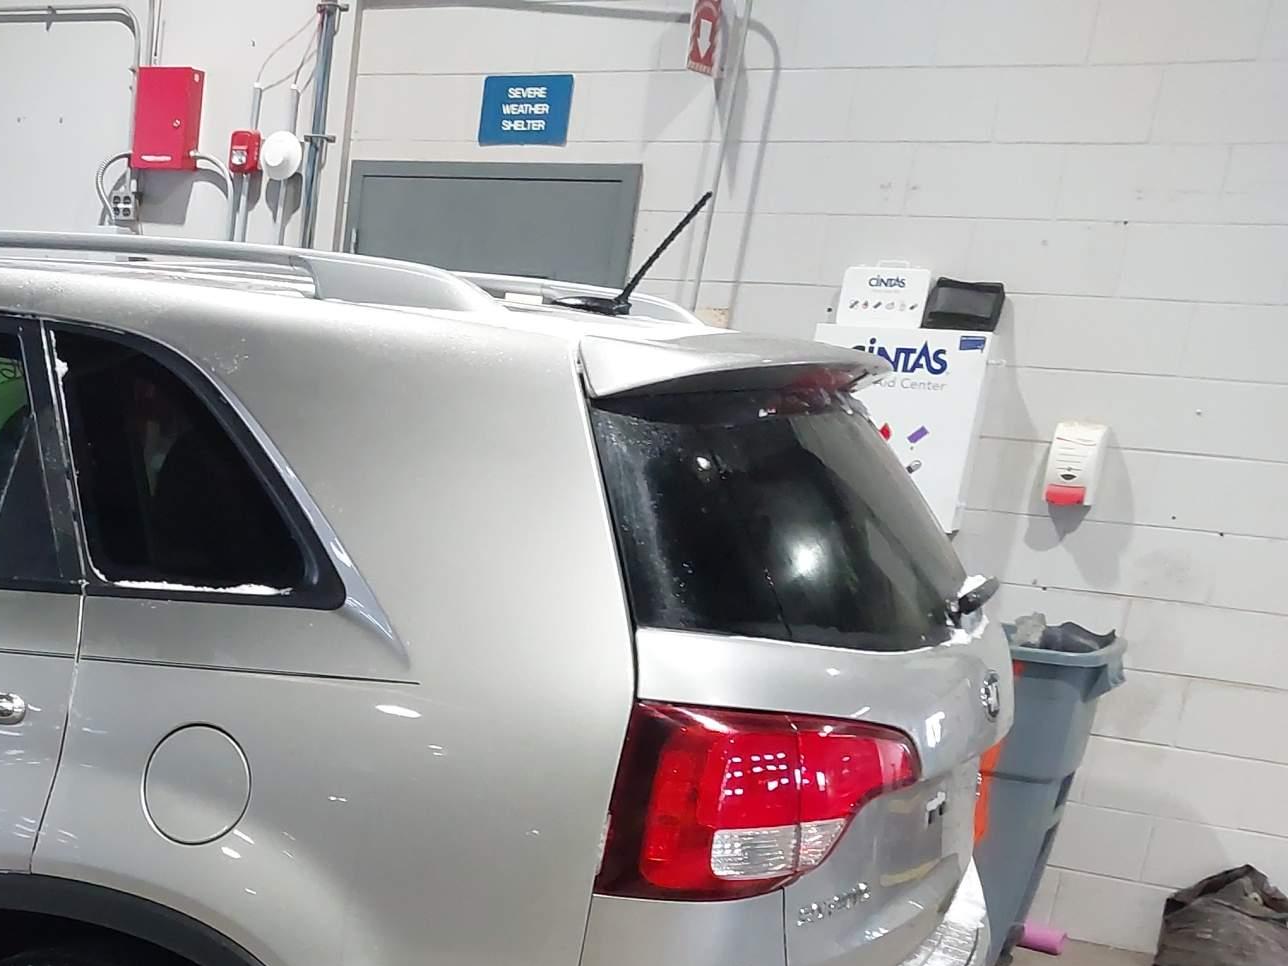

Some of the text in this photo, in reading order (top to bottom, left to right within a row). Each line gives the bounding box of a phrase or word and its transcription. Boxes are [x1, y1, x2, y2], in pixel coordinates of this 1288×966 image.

[507, 87, 548, 99] SEVERE
[501, 103, 550, 115] WEATHER
[500, 119, 546, 131] SHELTER
[900, 378, 947, 391] Center
